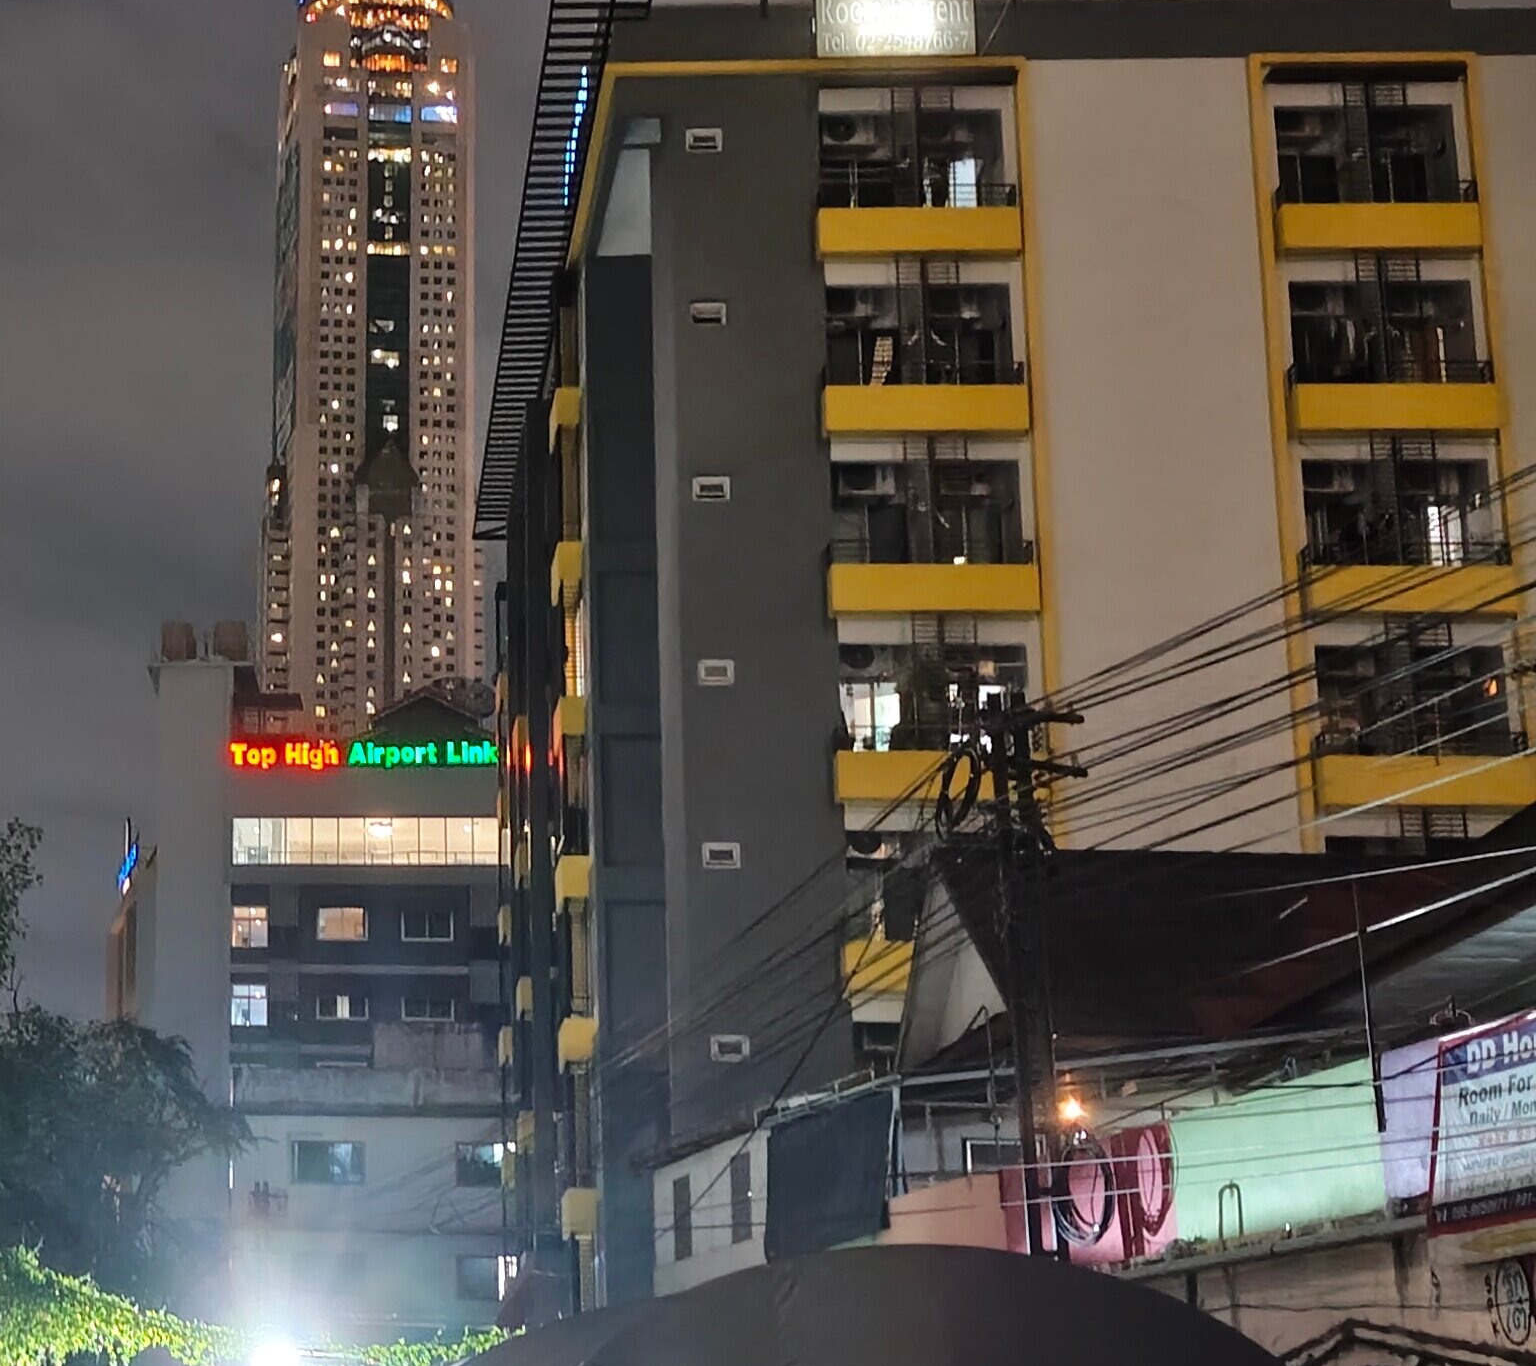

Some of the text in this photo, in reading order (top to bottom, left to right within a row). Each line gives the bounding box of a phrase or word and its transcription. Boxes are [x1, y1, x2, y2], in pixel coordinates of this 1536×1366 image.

[824, 33, 850, 52] Tel.
[230, 740, 499, 770] Top High Airport Link
[1466, 1030, 1536, 1075] DD Ho
[1458, 1073, 1534, 1108] Room For
